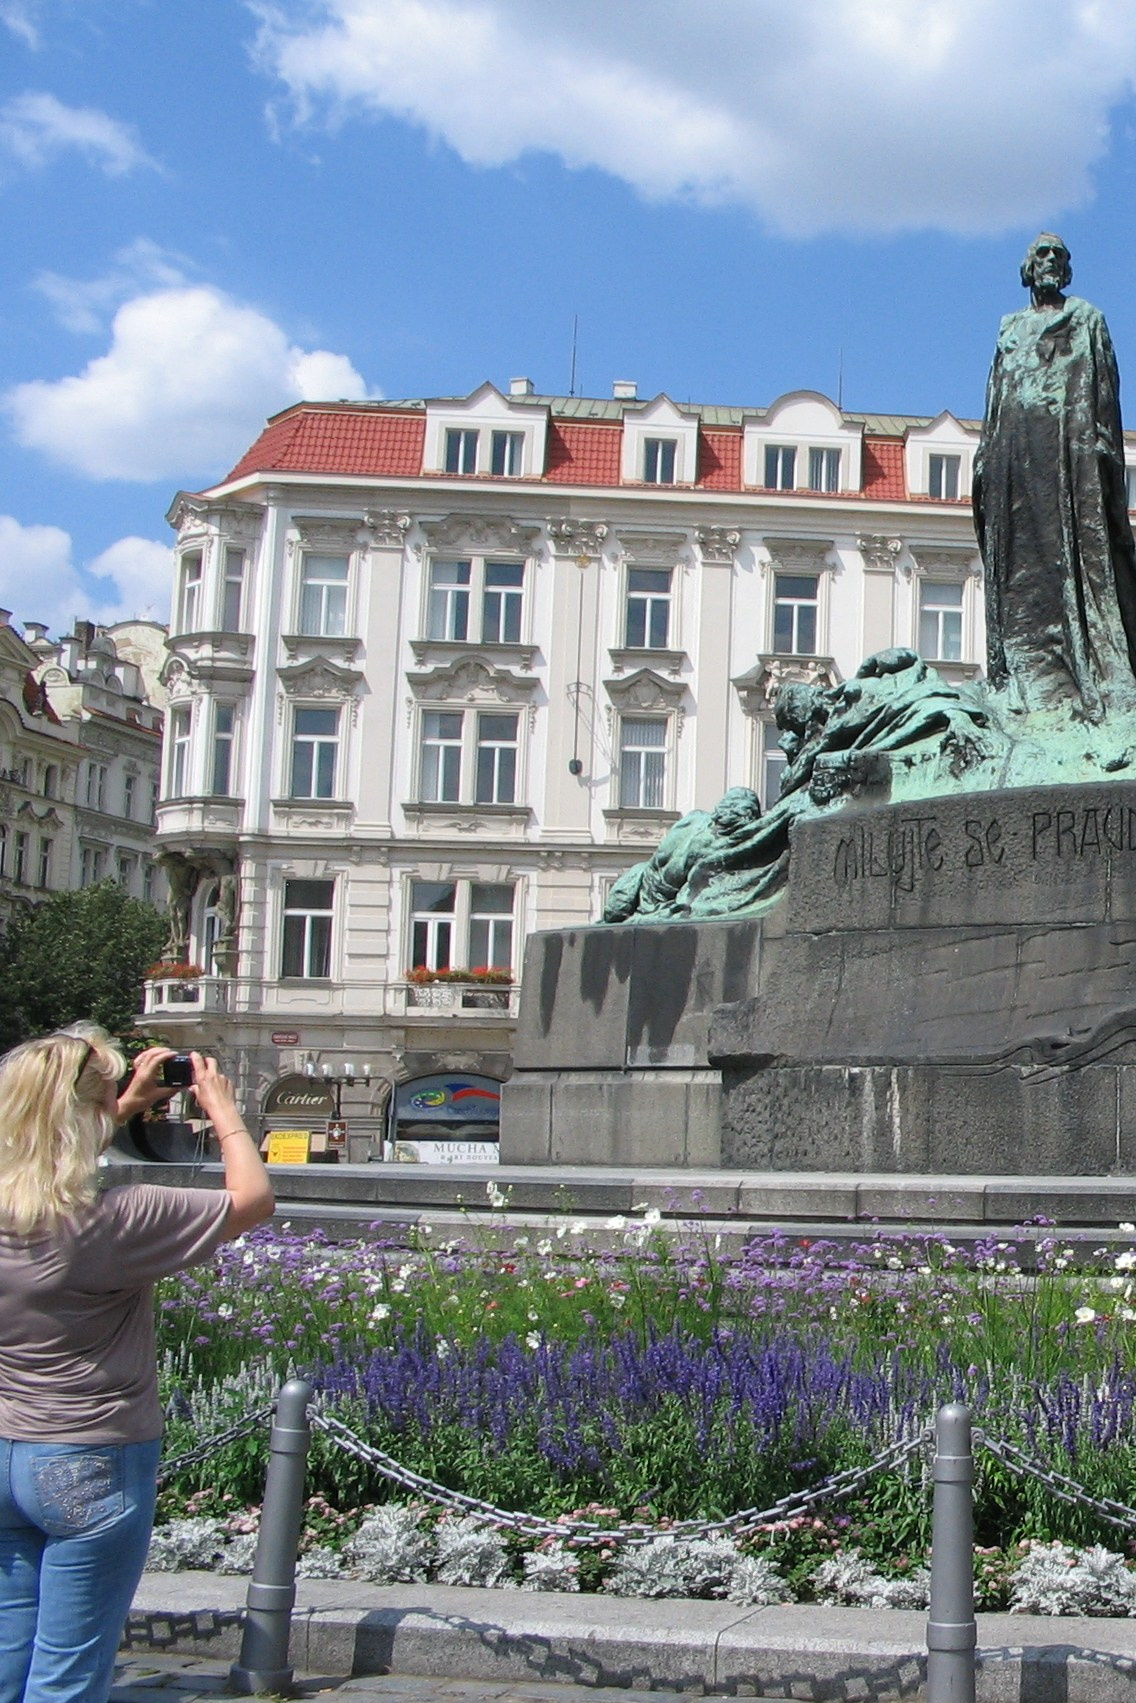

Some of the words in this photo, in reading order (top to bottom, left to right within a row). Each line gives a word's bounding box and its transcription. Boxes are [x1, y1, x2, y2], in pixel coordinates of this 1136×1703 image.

[965, 818, 1005, 868] SE
[276, 1090, 328, 1105] Cartier
[433, 1143, 488, 1154] MUCHA
